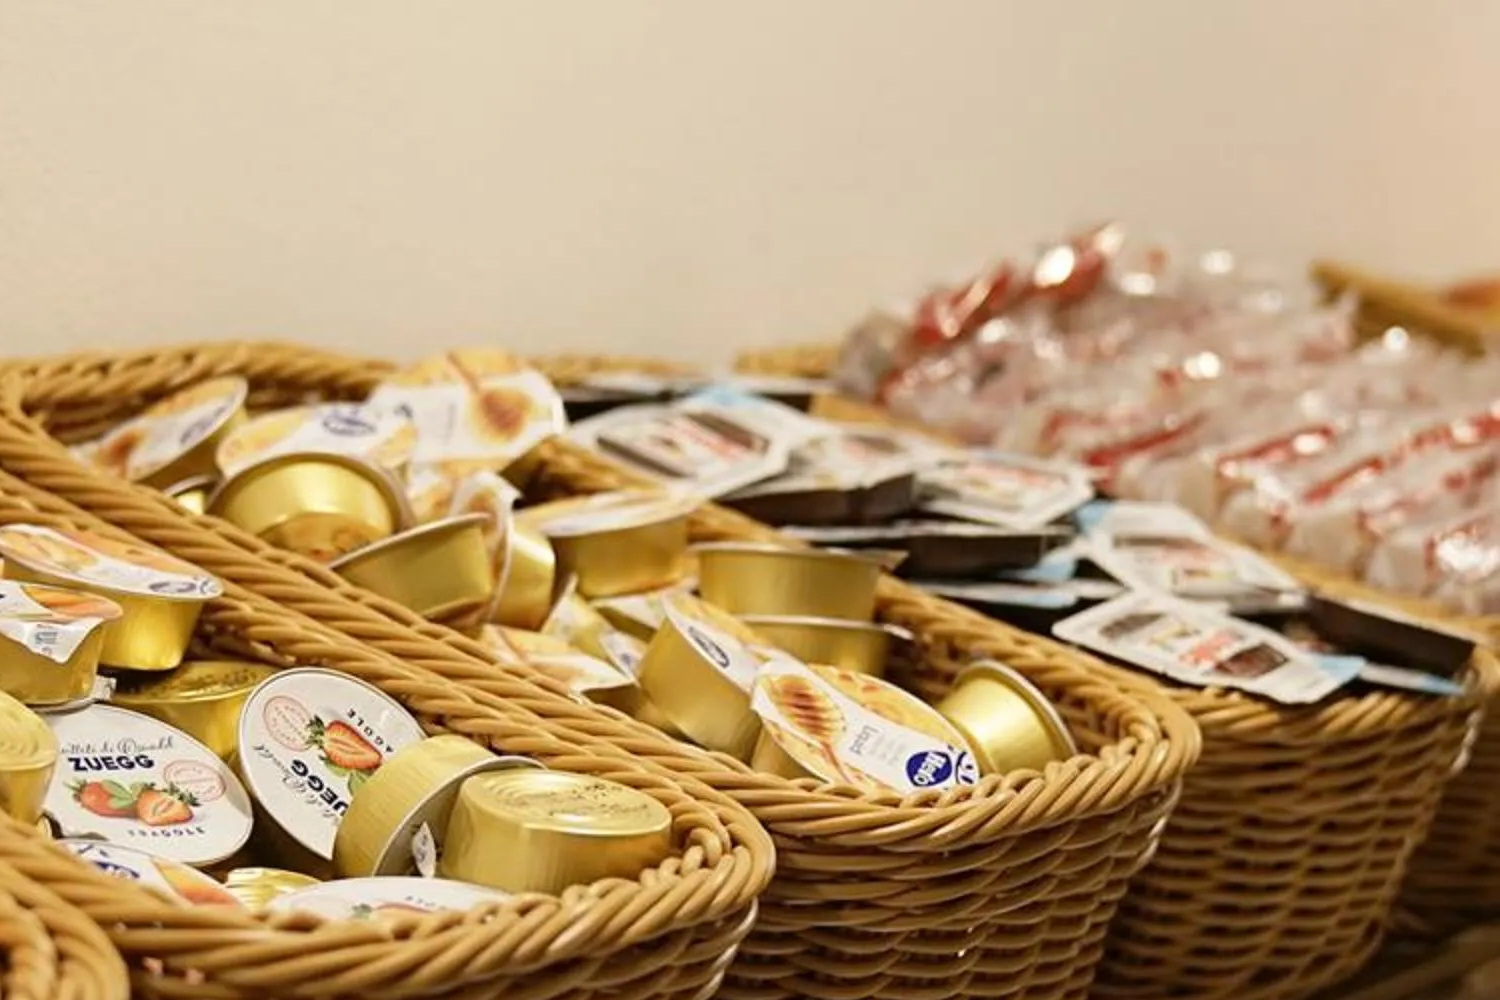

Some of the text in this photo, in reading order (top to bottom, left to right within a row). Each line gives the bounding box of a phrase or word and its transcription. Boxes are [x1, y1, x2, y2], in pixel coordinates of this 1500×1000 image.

[347, 707, 394, 754] AGOLE
[68, 754, 155, 772] ZUEGG
[912, 752, 947, 785] Hero
[290, 759, 349, 817] UEGG
